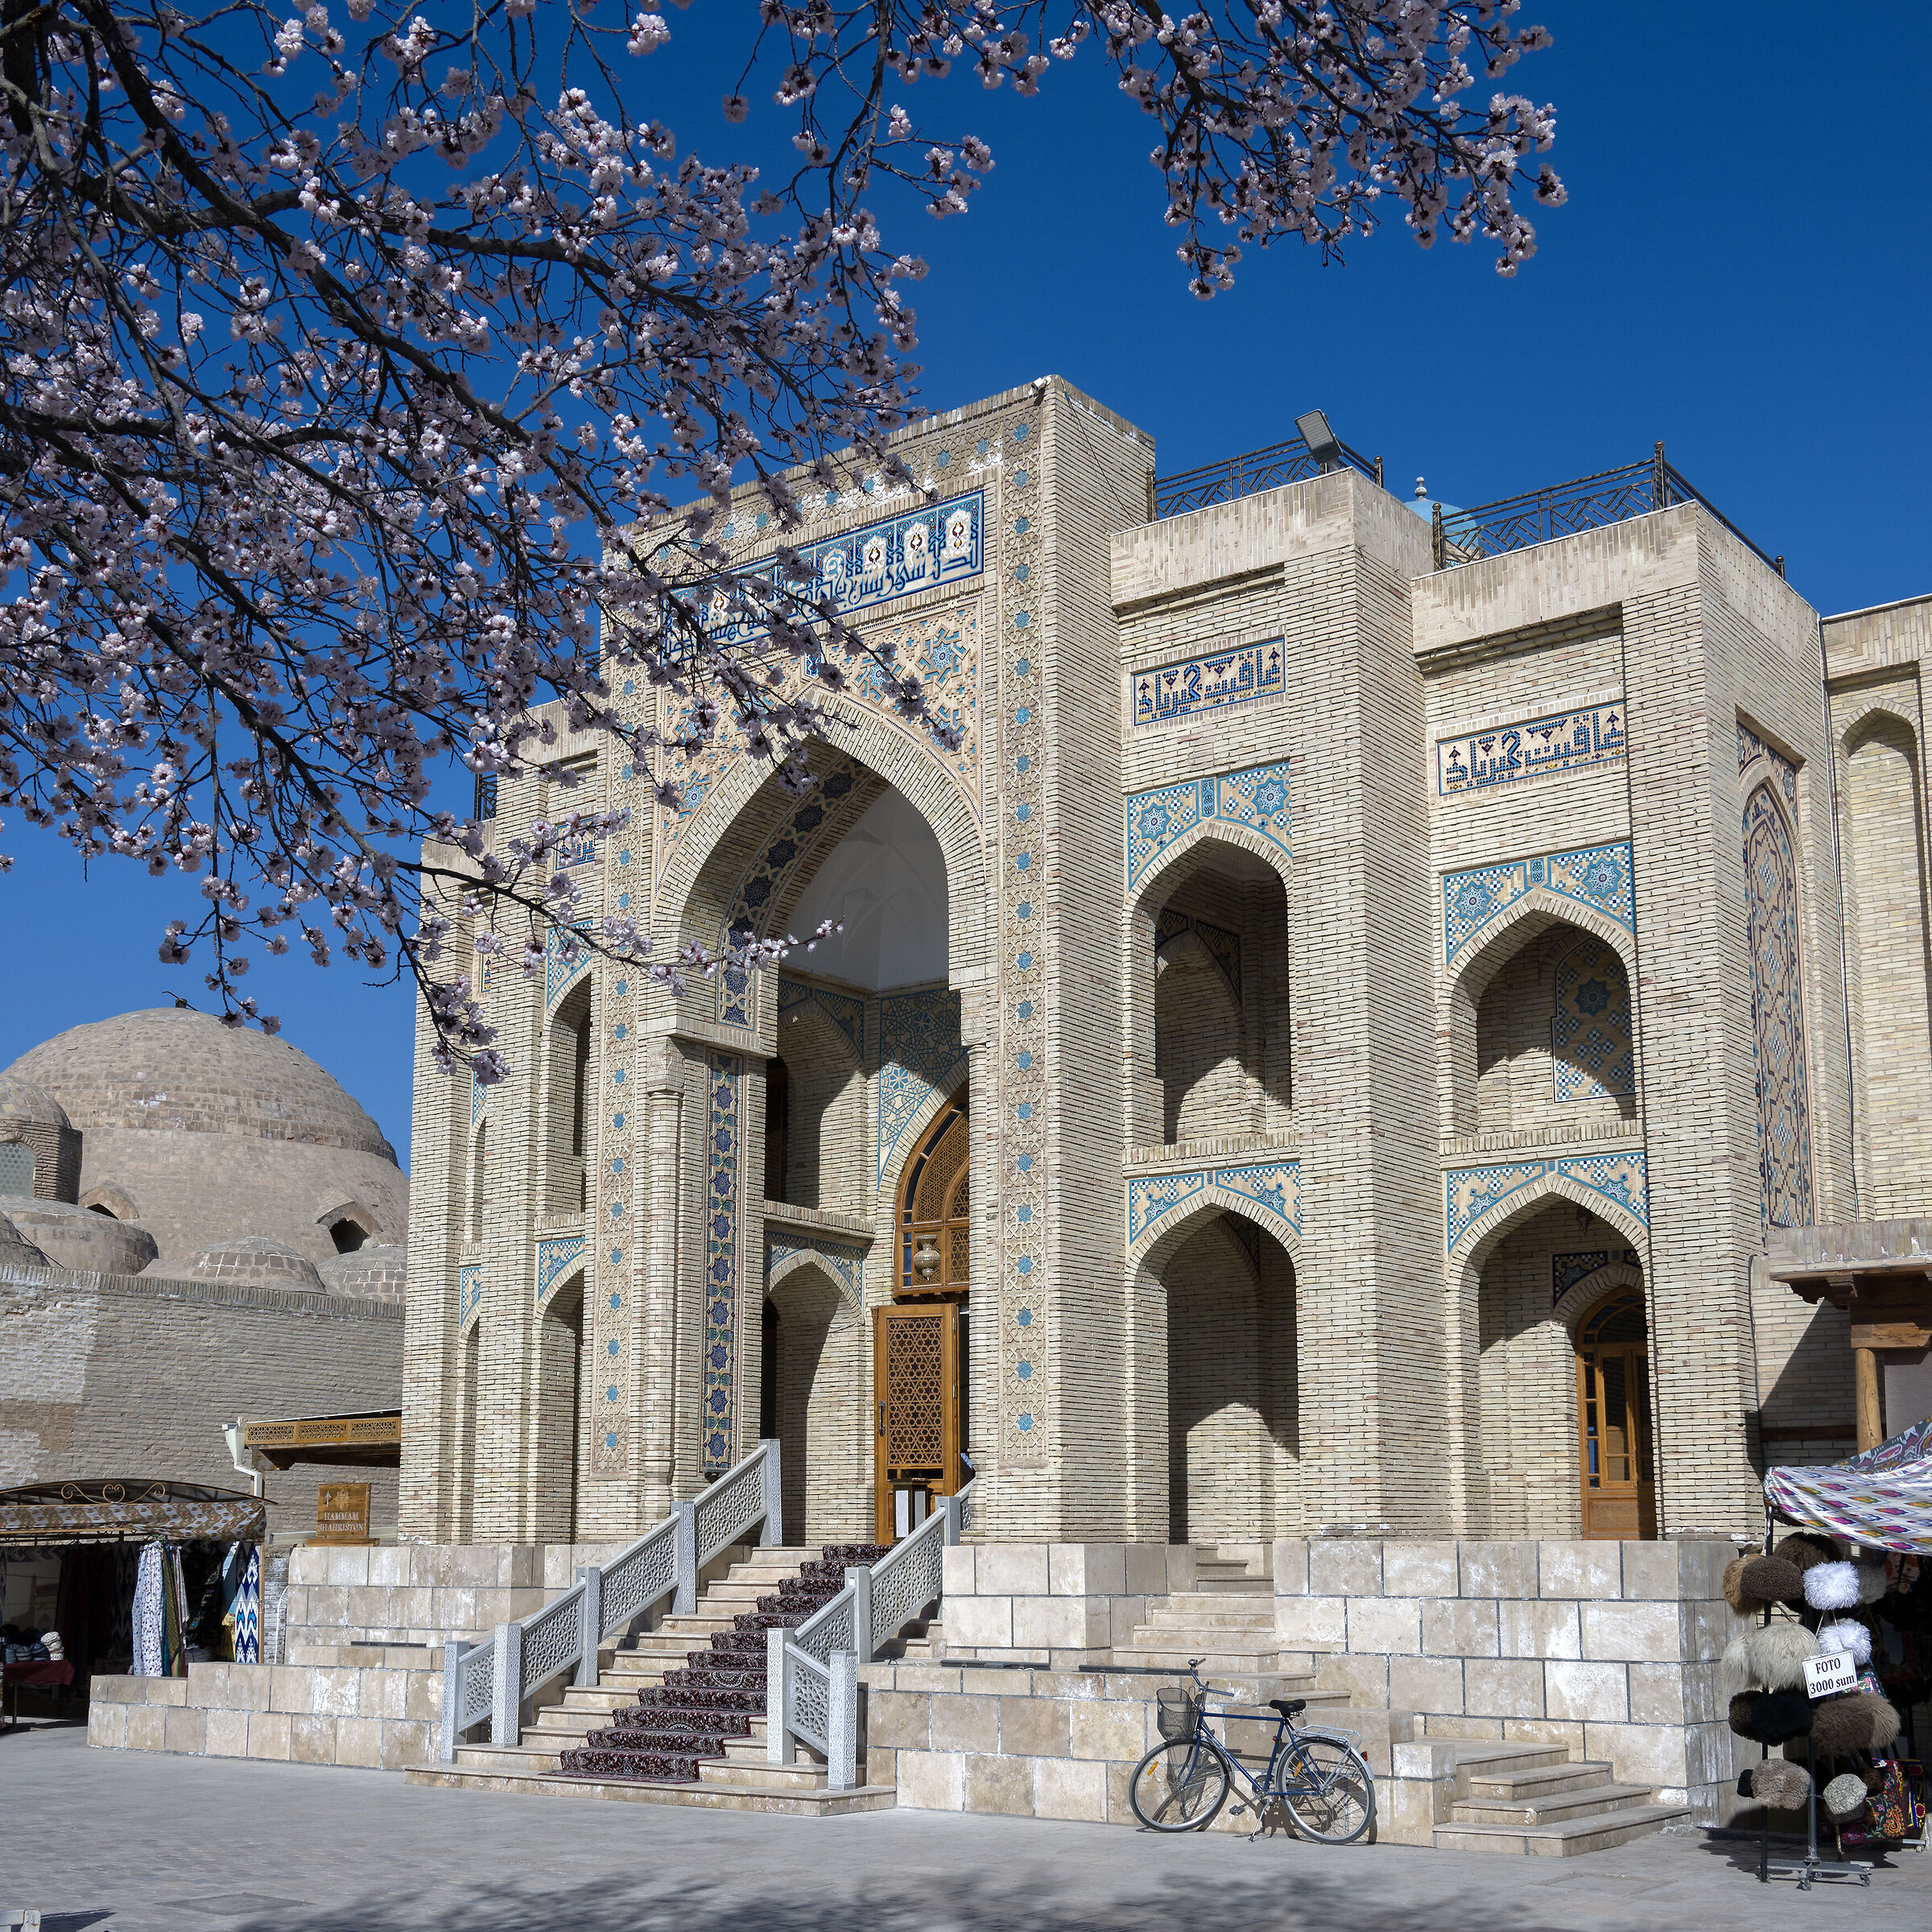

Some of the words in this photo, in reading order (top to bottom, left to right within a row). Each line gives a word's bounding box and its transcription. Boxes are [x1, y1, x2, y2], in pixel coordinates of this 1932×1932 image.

[324, 1512, 359, 1521] HAMMAM
[318, 1523, 364, 1532] SHAHRISTON
[1815, 1657, 1840, 1674] FOTO
[1810, 1678, 1833, 1694] 3000
[1835, 1674, 1855, 1687] sum
